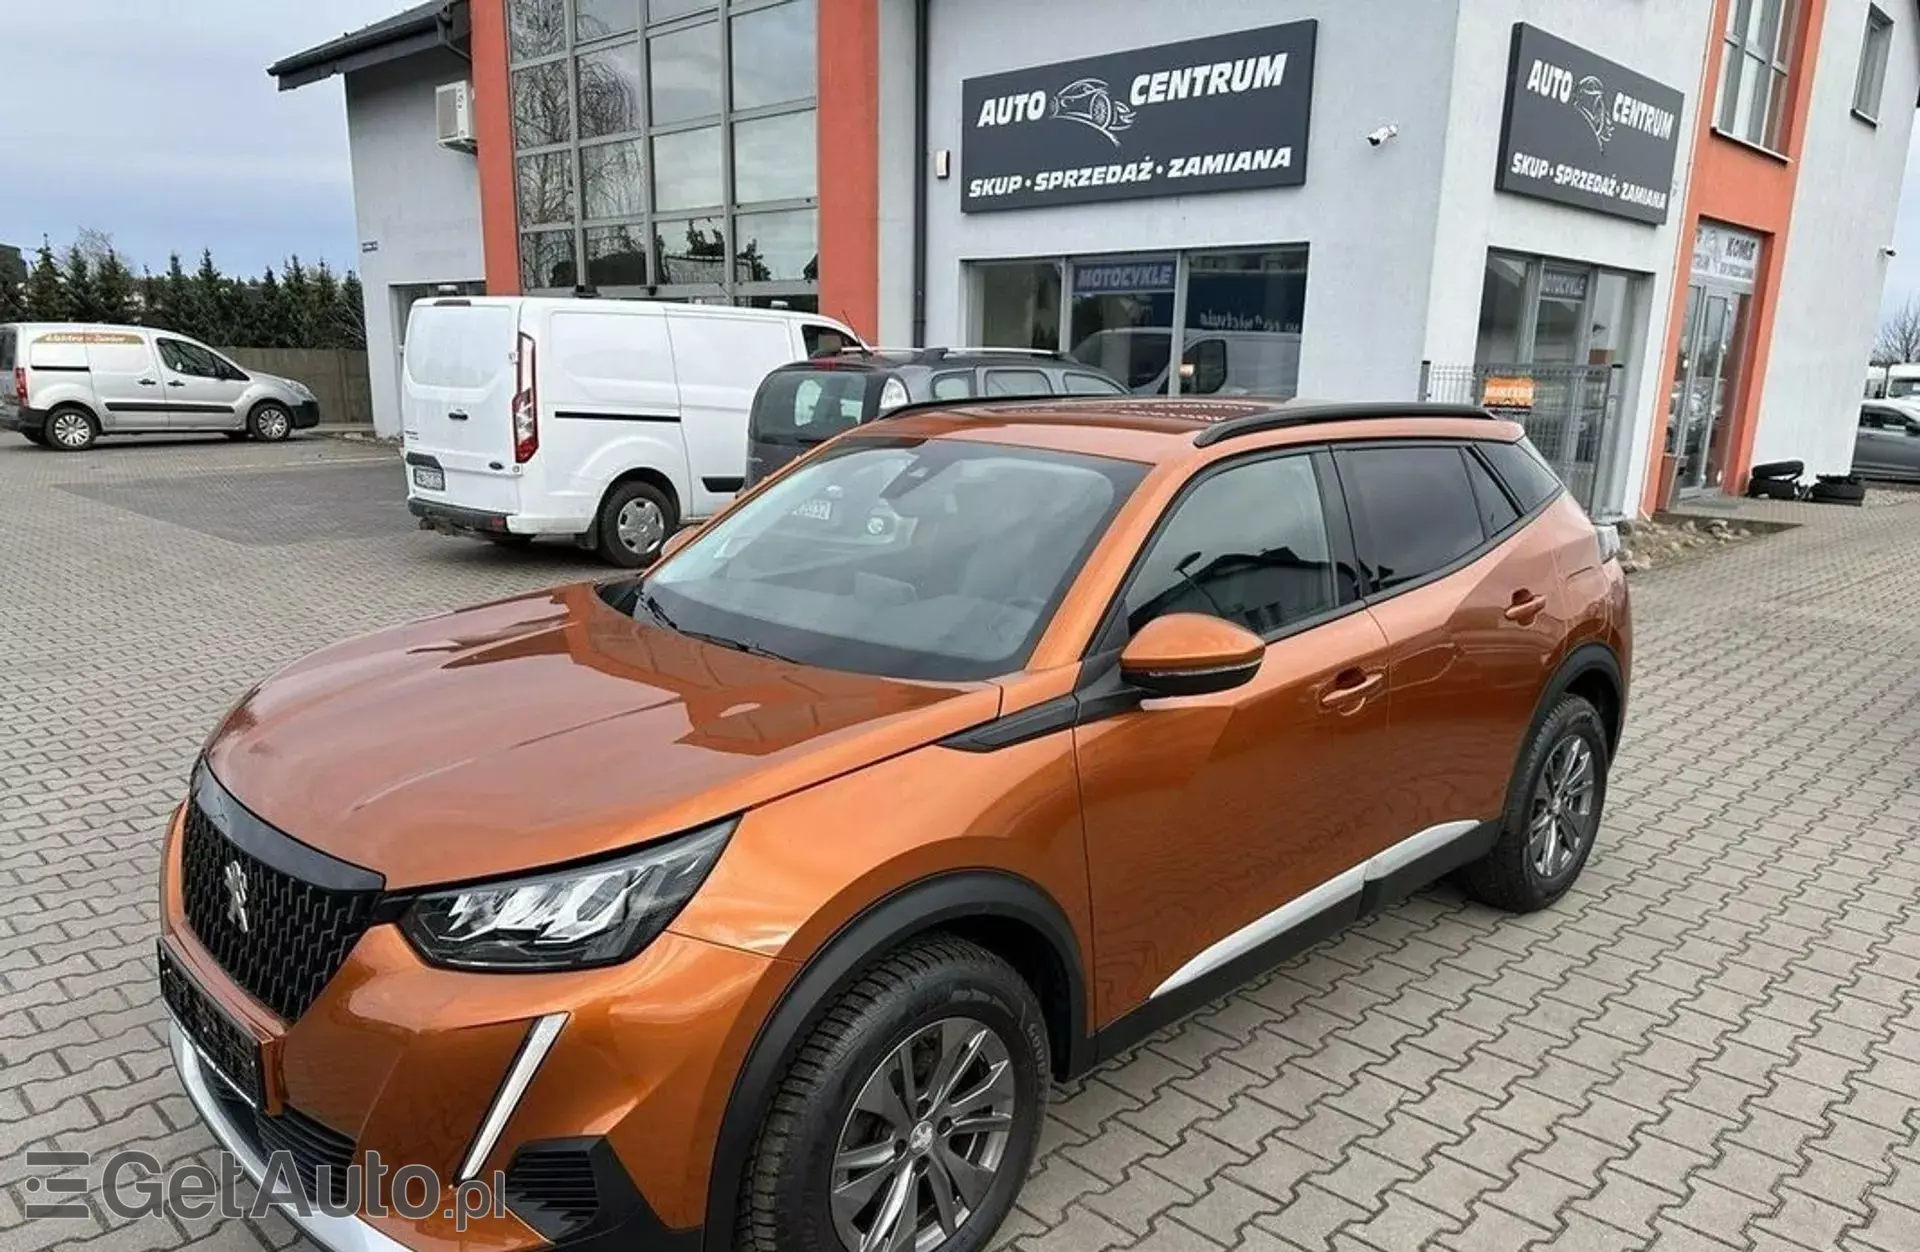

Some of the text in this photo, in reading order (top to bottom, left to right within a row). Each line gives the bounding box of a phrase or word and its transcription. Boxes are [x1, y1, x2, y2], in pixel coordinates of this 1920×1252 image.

[977, 53, 1288, 128] AUTO CENTRUM
[1527, 59, 1675, 141] AUTO CENTRUM
[968, 147, 1292, 198] SKUP SPRZEDAŻ ZAMIANA
[1511, 152, 1667, 210] SKUP SPRZEDAŻ ZAMIANA
[1077, 264, 1173, 287] MOTOCYKLE
